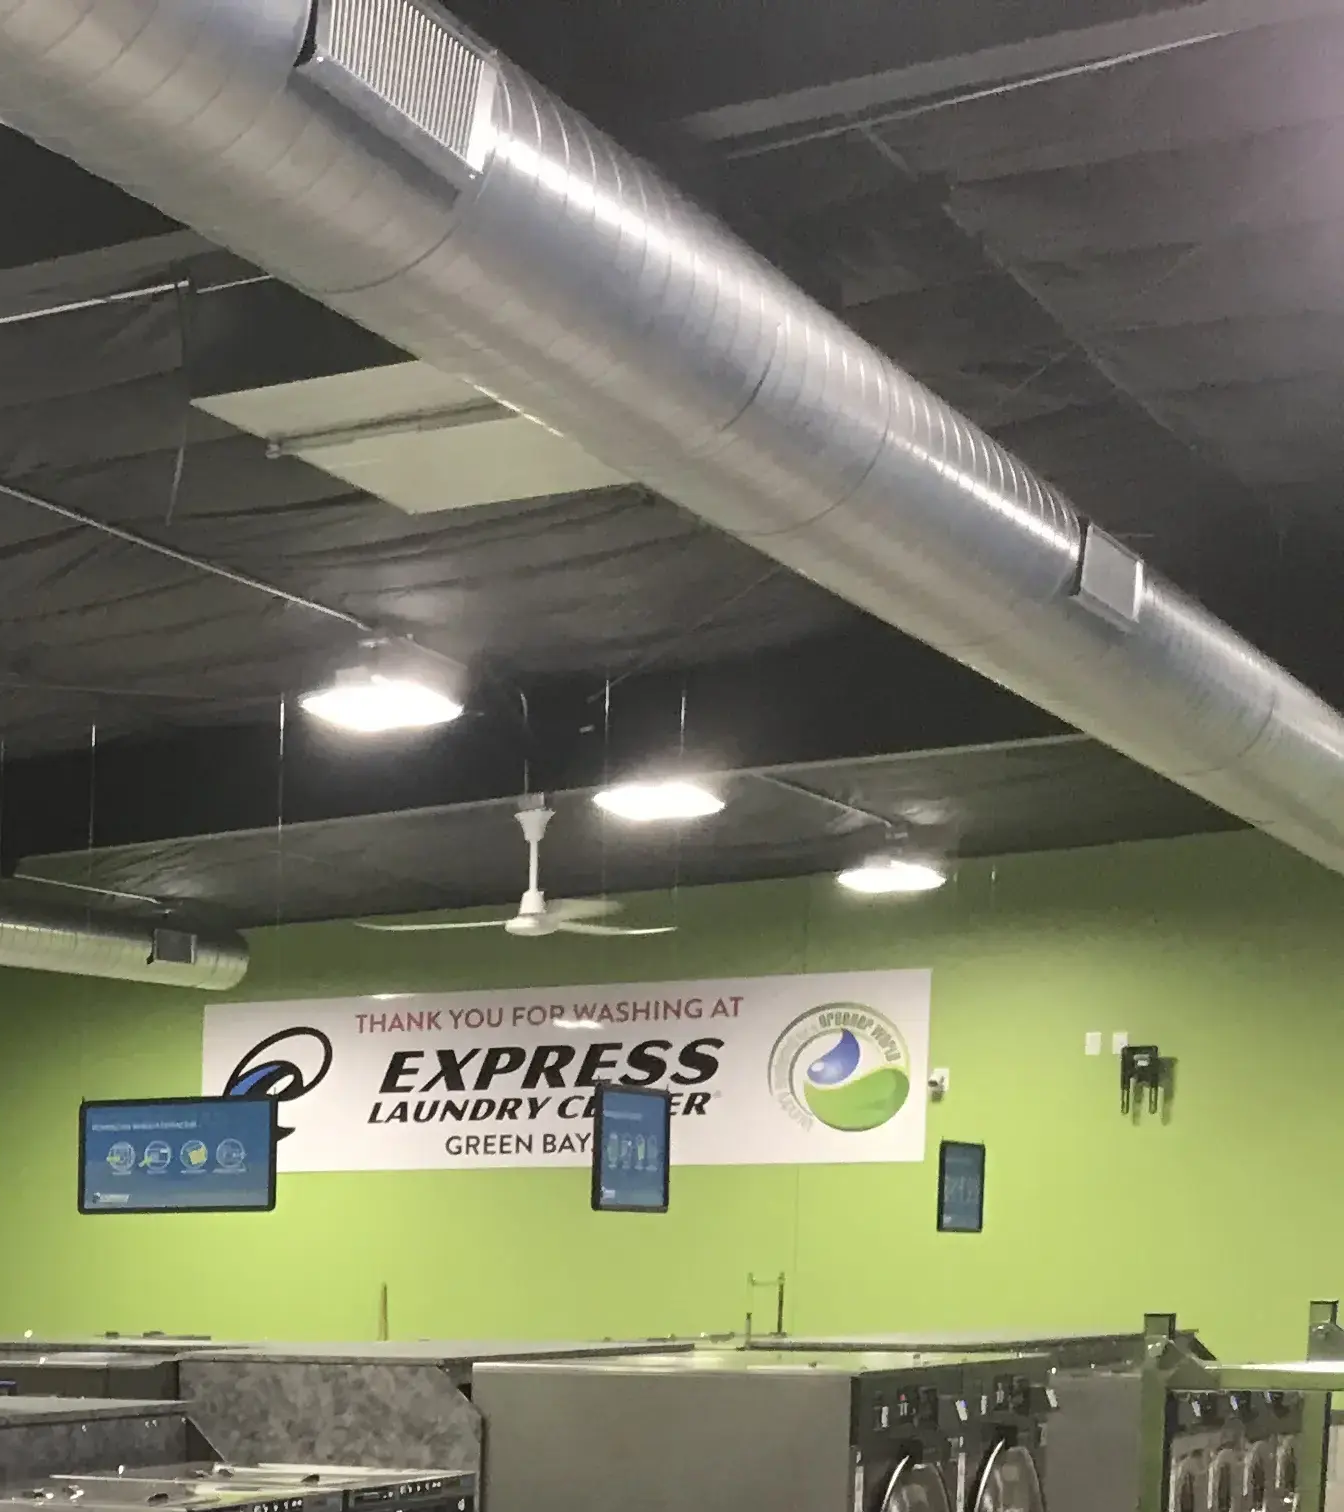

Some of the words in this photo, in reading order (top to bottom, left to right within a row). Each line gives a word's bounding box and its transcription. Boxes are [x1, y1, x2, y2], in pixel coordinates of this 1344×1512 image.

[355, 1010, 442, 1034] THANK
[449, 1007, 504, 1030] YOU
[512, 1004, 565, 1027] FOR
[573, 998, 703, 1024] WASHING
[709, 996, 744, 1019] AT
[378, 1037, 726, 1094] EXPRESS
[367, 1096, 552, 1124] LAUNDRY
[558, 1091, 712, 1120] CEER
[444, 1134, 533, 1155] GREEN
